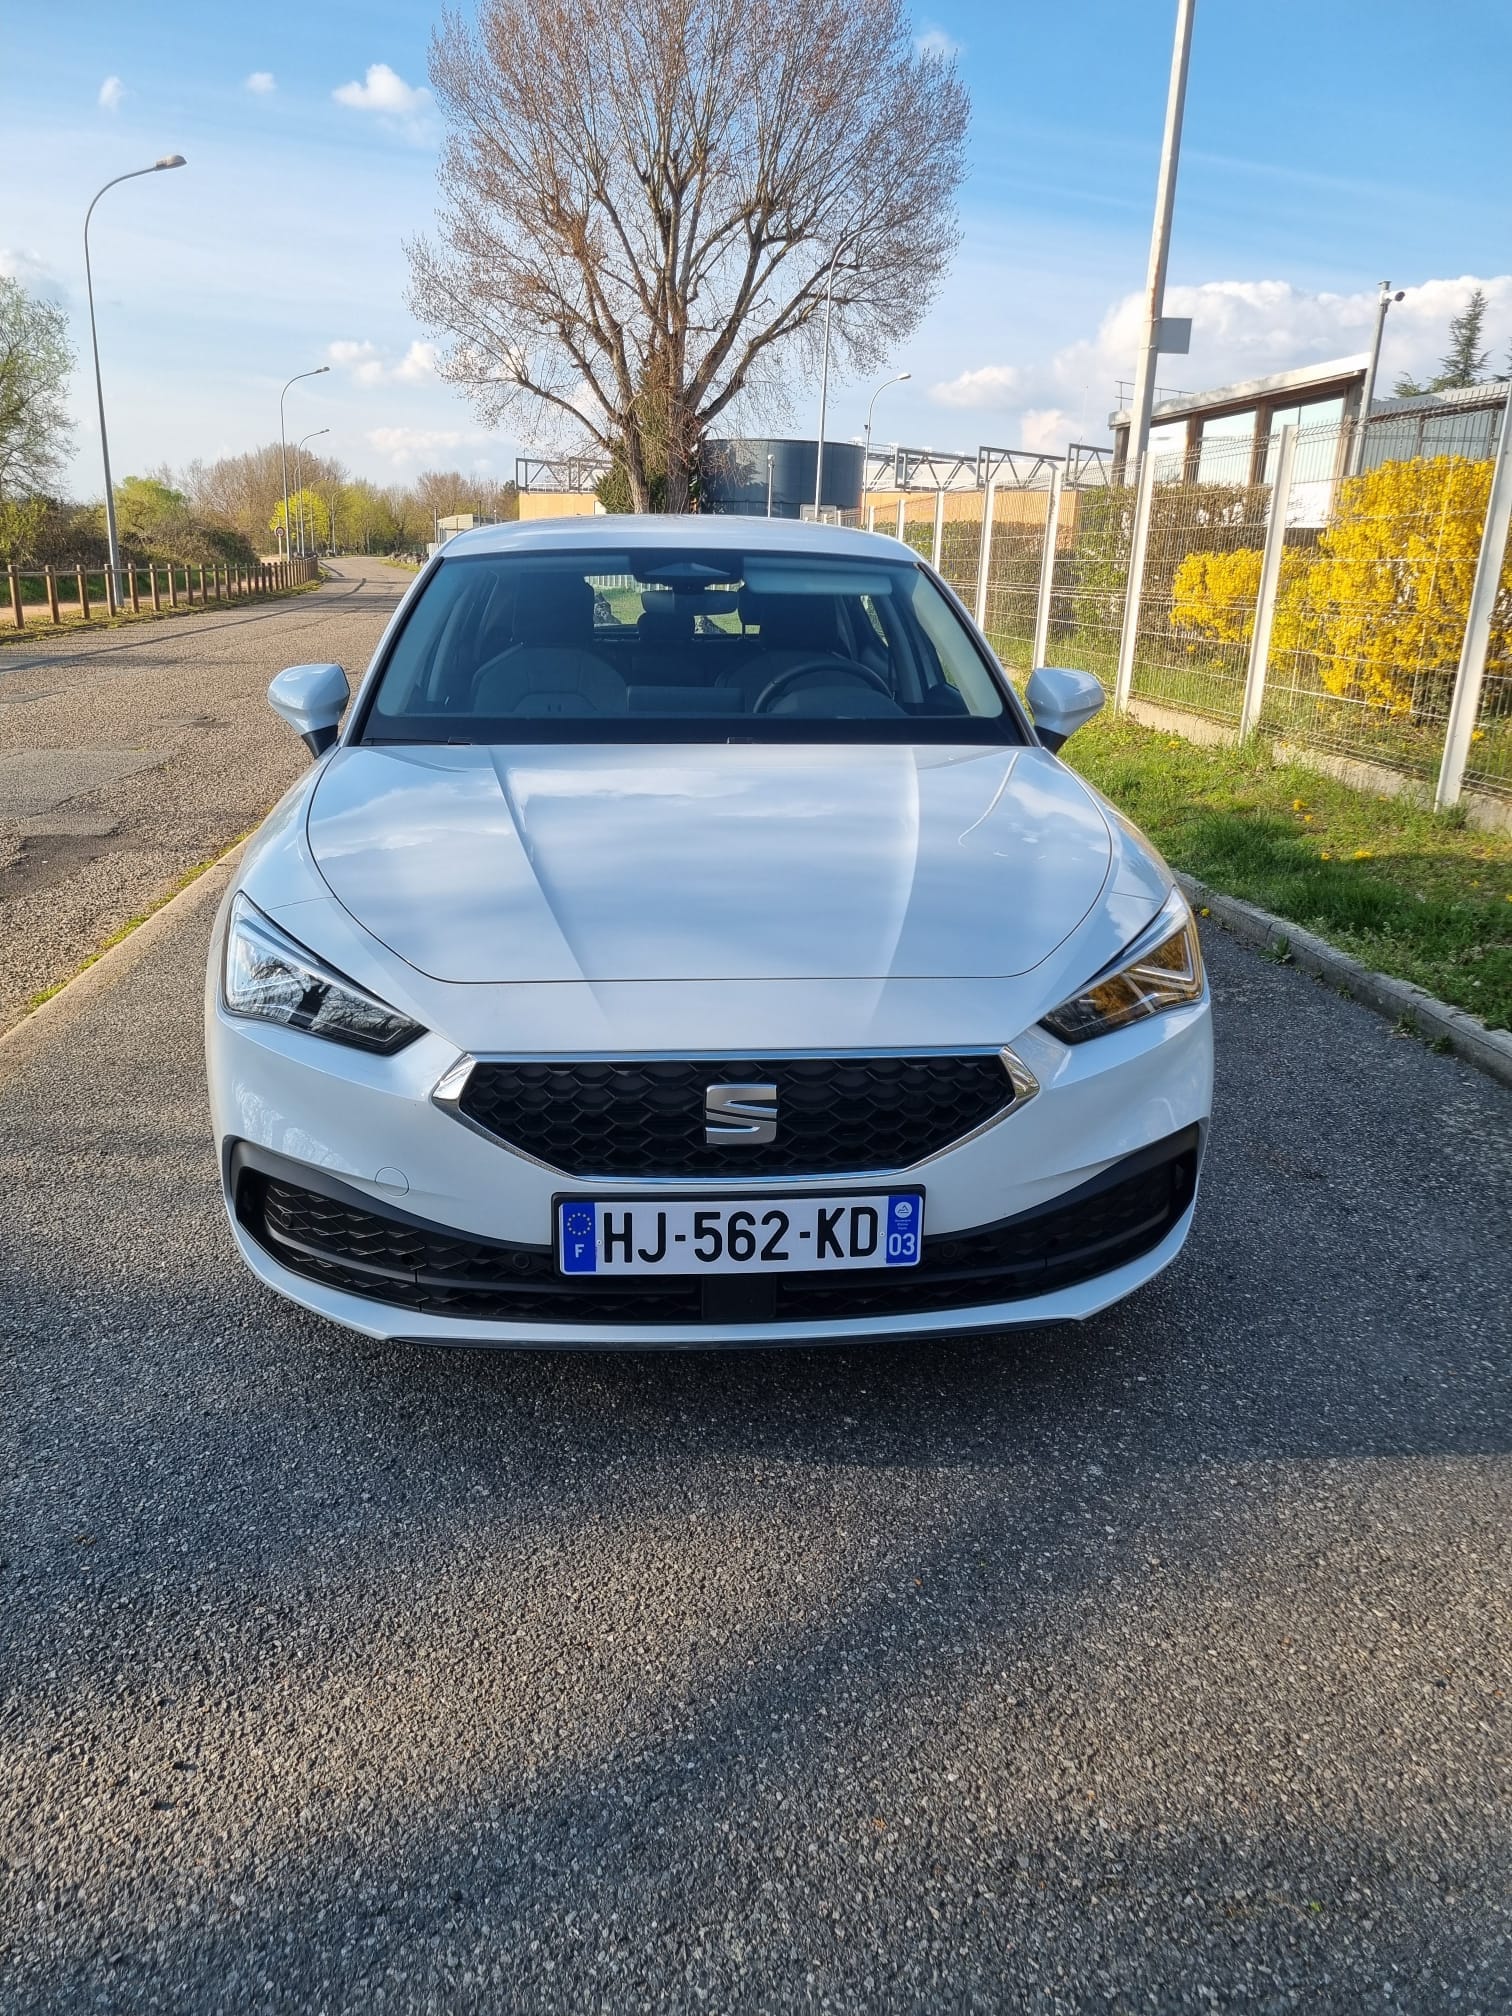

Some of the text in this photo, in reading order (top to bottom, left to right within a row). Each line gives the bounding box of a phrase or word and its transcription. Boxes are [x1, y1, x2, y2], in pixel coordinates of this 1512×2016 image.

[603, 1206, 879, 1264] HJ-562-KD
[889, 1233, 915, 1256] 03
[575, 1243, 585, 1258] F
